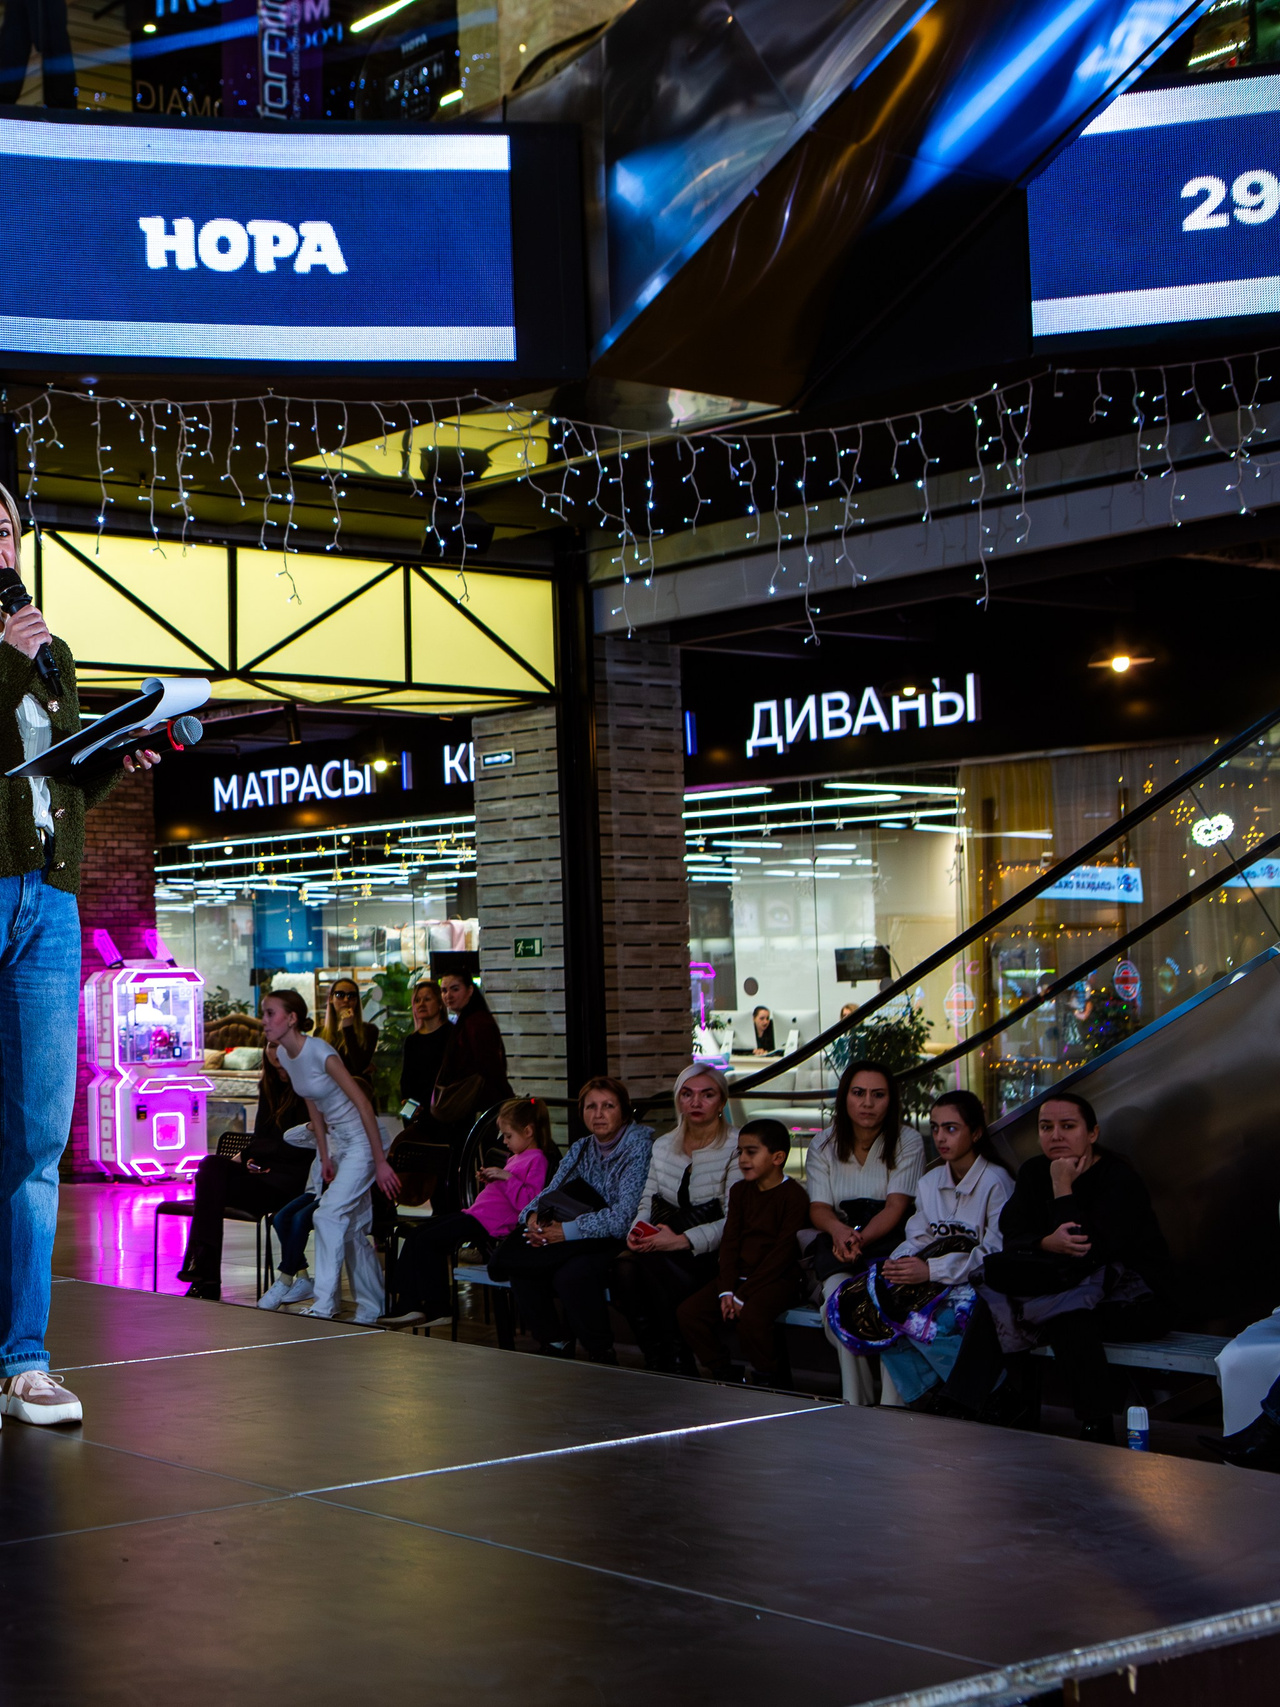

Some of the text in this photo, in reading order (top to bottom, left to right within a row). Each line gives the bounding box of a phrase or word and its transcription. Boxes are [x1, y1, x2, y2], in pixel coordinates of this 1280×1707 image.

[1179, 168, 1280, 232] 29
[138, 216, 348, 275] НОРА
[746, 672, 977, 758] ДИВАНЫ
[213, 757, 373, 812] МАТРАСЫ
